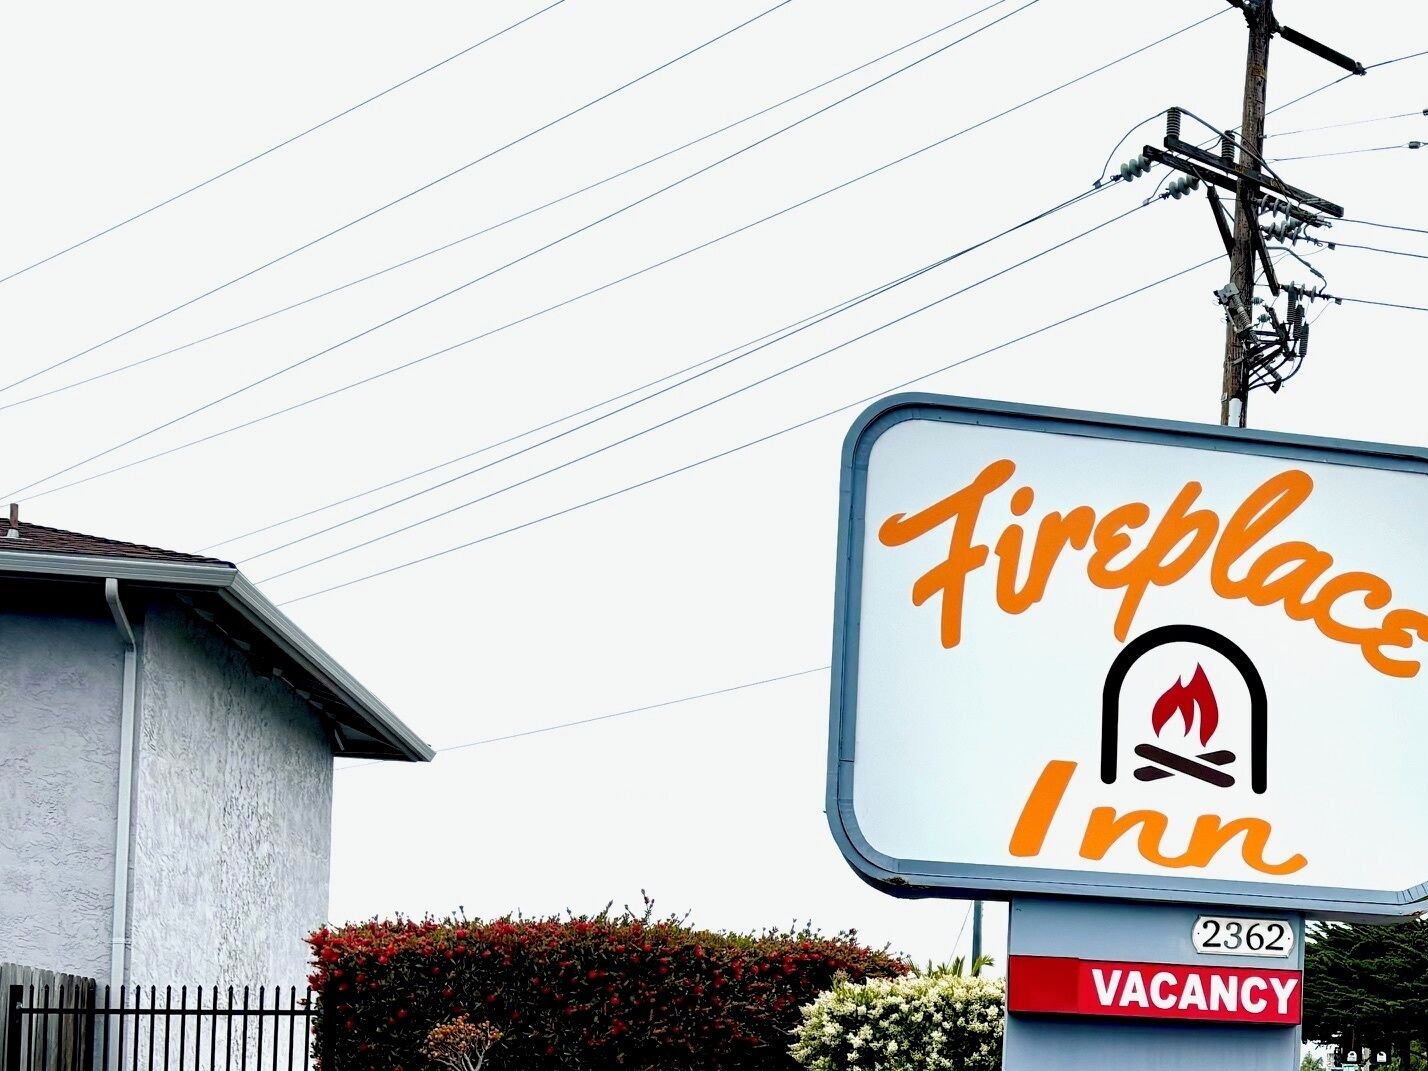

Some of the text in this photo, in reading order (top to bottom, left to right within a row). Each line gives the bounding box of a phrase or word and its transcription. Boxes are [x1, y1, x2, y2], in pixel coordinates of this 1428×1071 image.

[1008, 760, 1308, 875] Inn
[1202, 920, 1285, 951] 2362
[1091, 968, 1299, 1015] VACANCY
